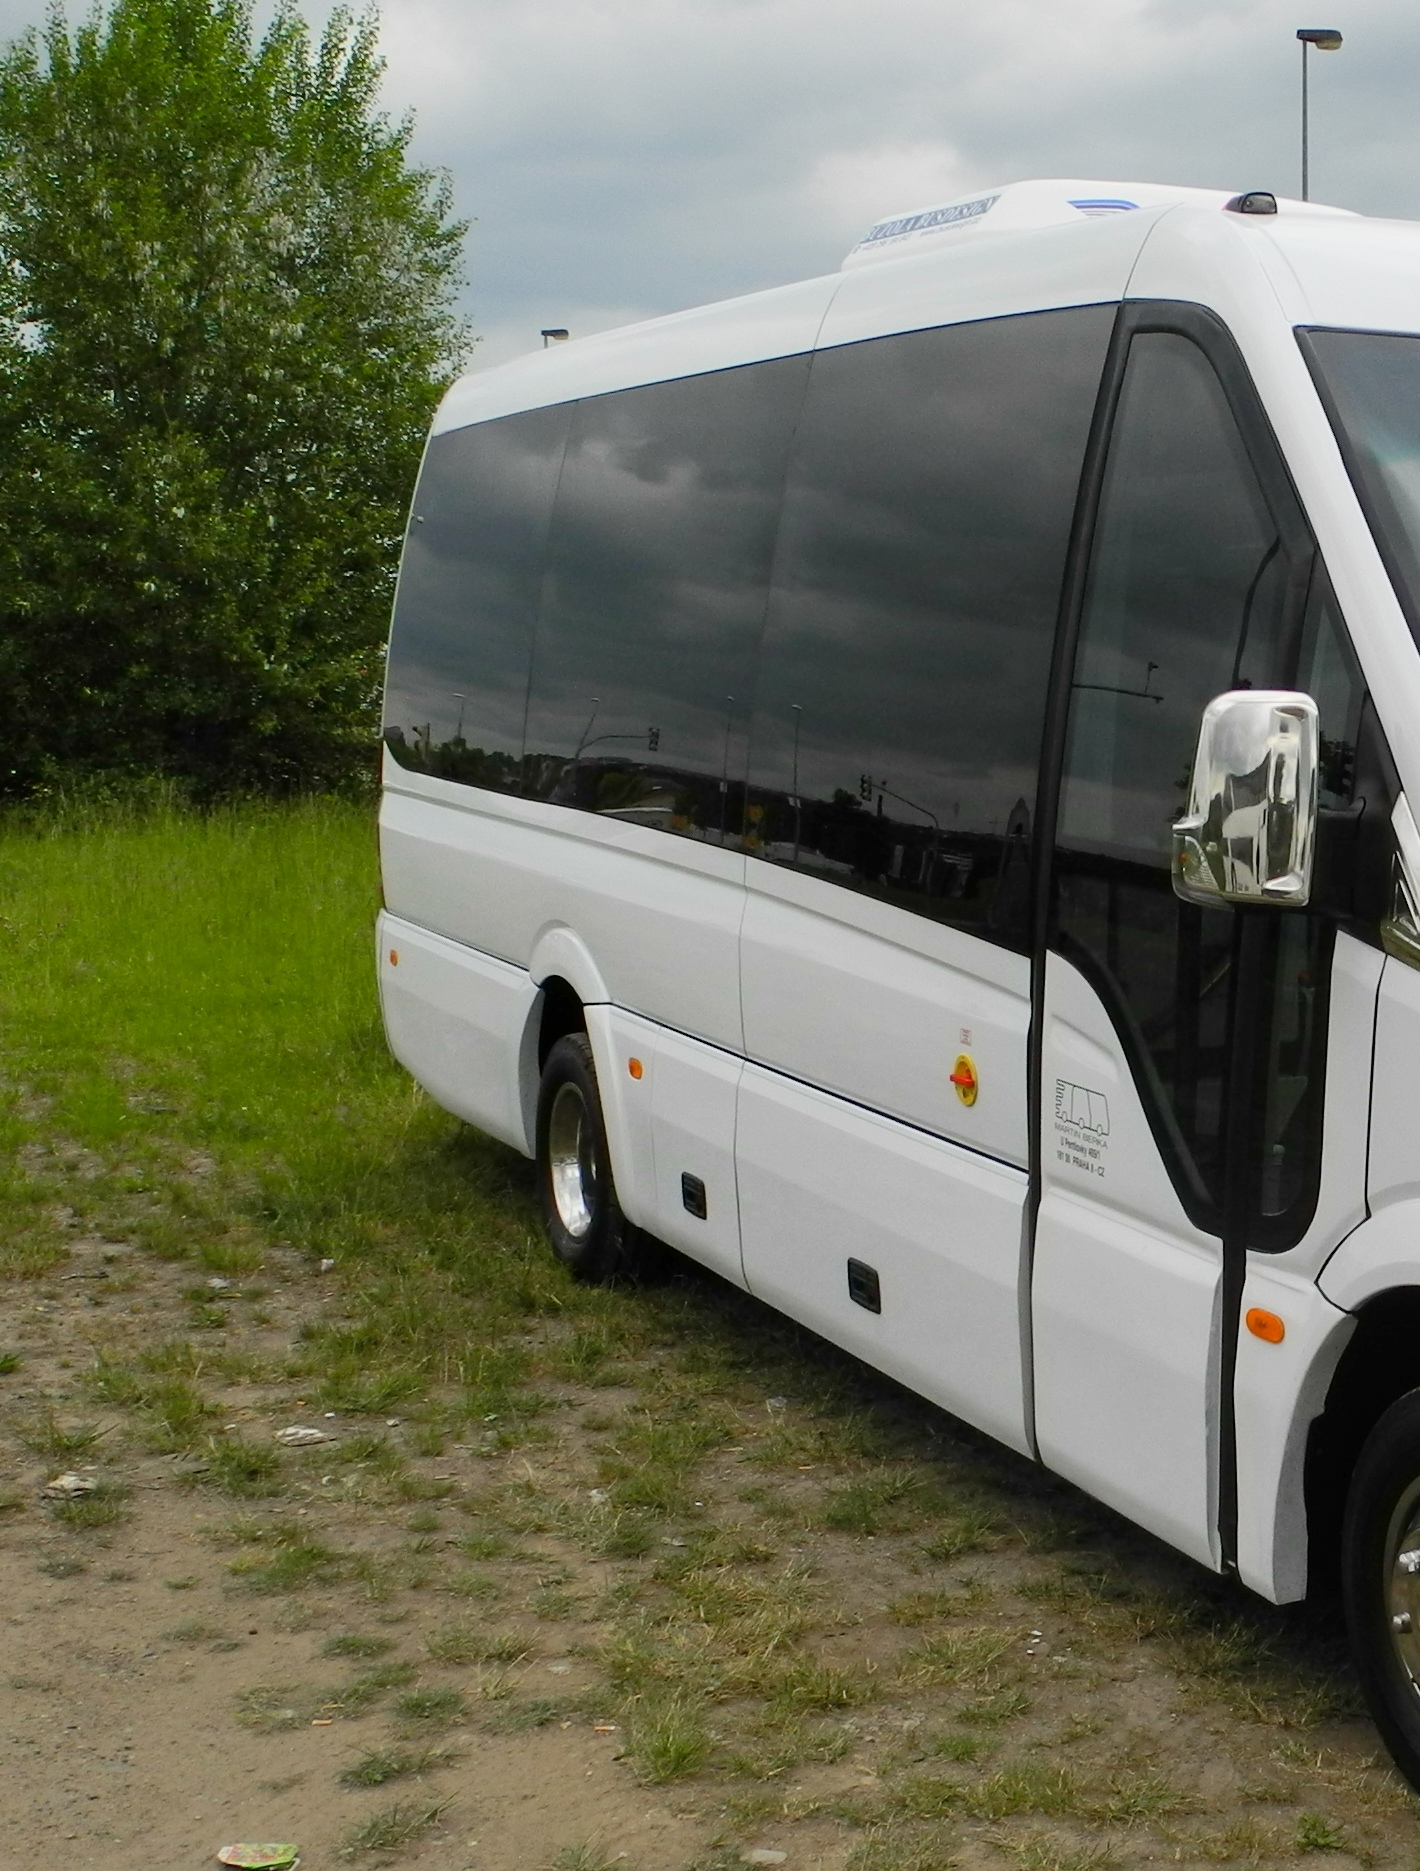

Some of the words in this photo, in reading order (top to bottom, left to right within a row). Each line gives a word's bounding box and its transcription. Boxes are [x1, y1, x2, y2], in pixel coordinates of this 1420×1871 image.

[1054, 1122, 1081, 1139] MARTIN
[1082, 1133, 1108, 1149] BERKA
[1072, 1155, 1090, 1171] PRAHA
